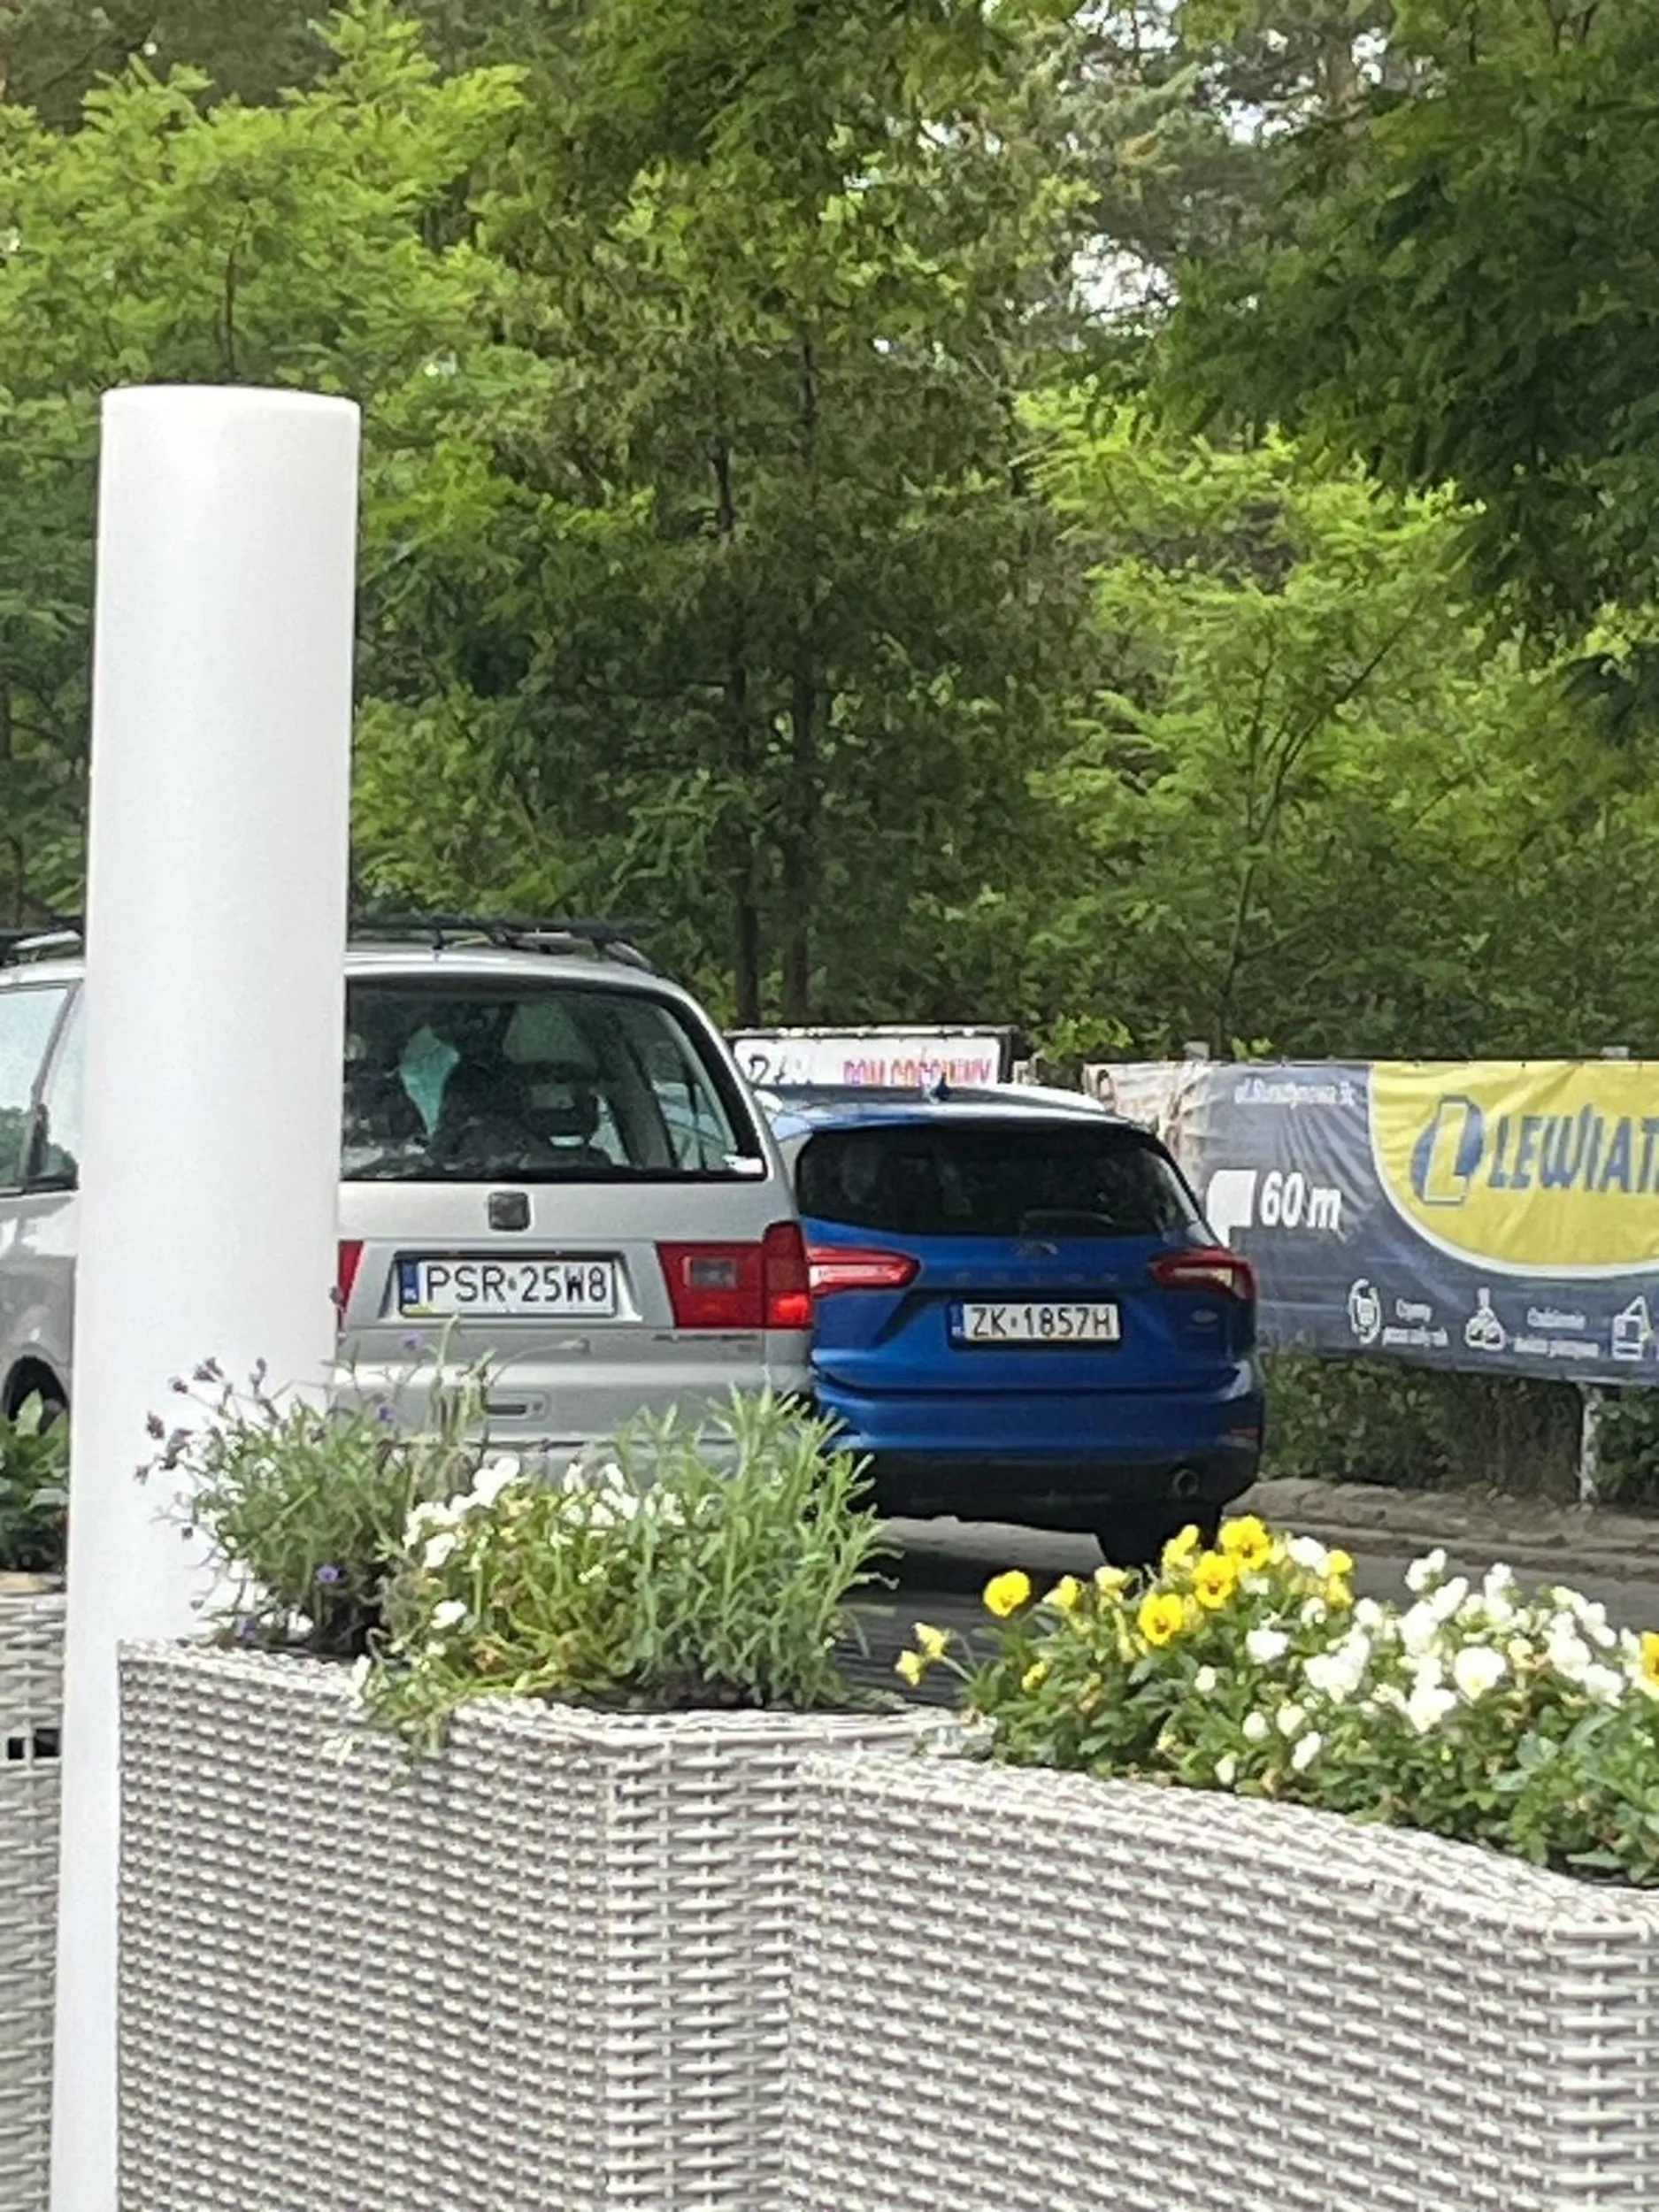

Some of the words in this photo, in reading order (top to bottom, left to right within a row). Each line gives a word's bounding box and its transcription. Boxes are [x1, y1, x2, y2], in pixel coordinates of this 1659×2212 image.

[426, 1265, 507, 1303] PSR
[520, 1265, 608, 1303] 25W8
[971, 1306, 1008, 1337] ZK
[1024, 1306, 1111, 1338] 1857H
